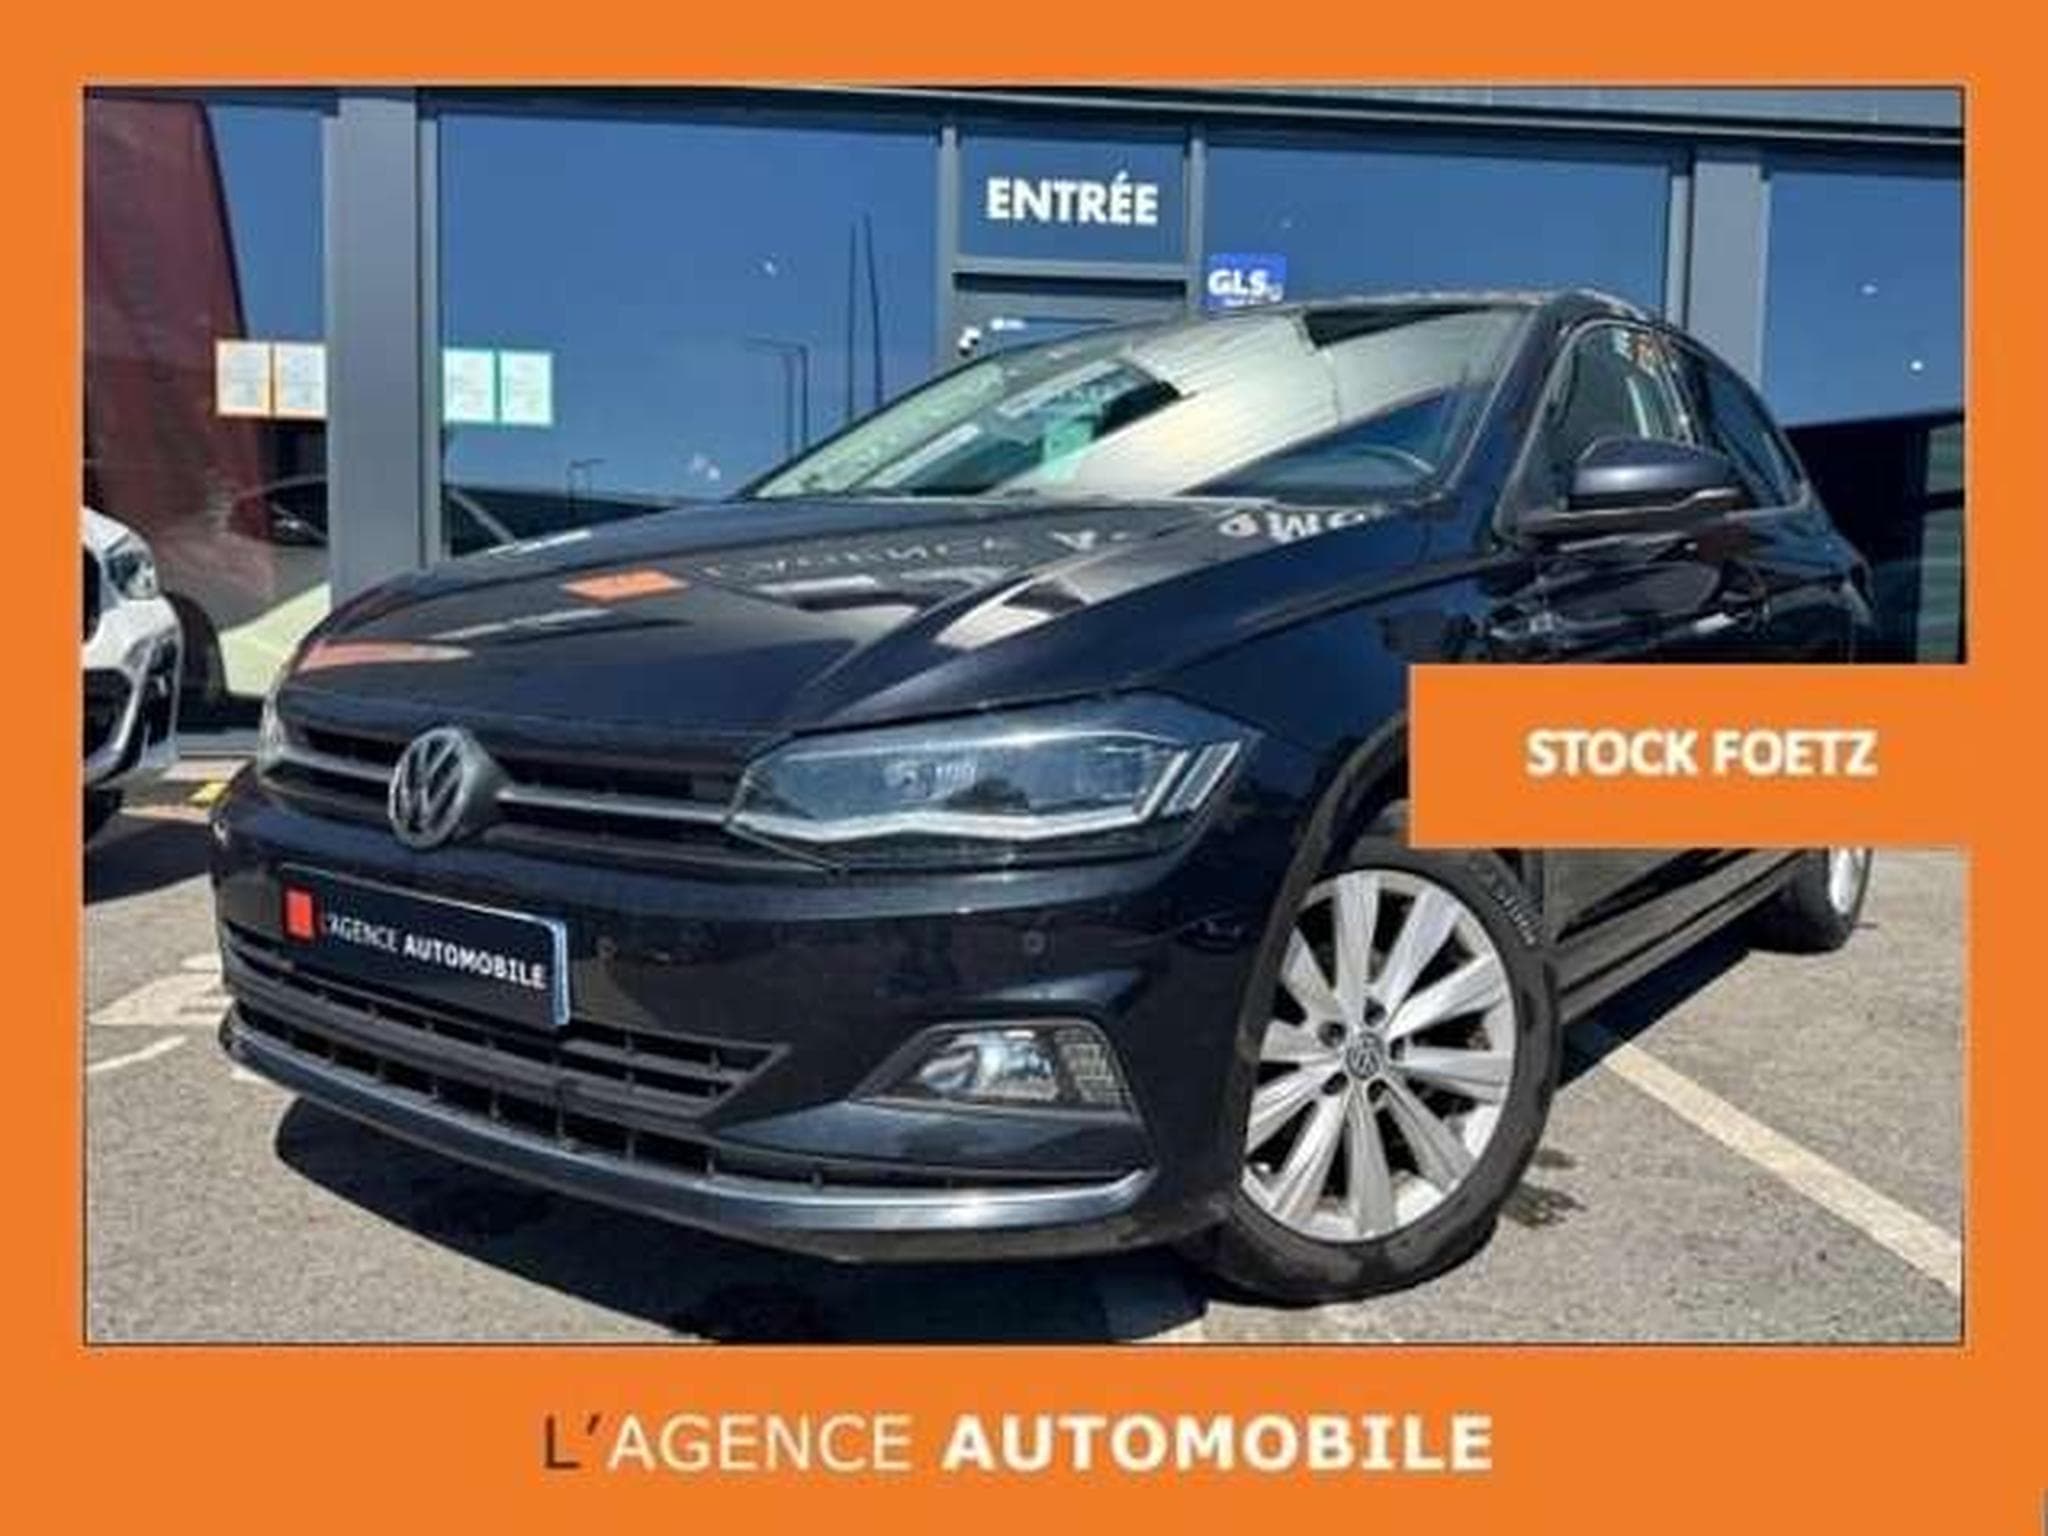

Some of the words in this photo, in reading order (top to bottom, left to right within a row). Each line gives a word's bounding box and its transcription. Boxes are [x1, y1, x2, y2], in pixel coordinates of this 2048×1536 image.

[986, 170, 1159, 226] ENTRÉE
[1207, 268, 1267, 297] GLS
[388, 726, 467, 848] VW
[404, 933, 547, 991] AUTOMOBILE
